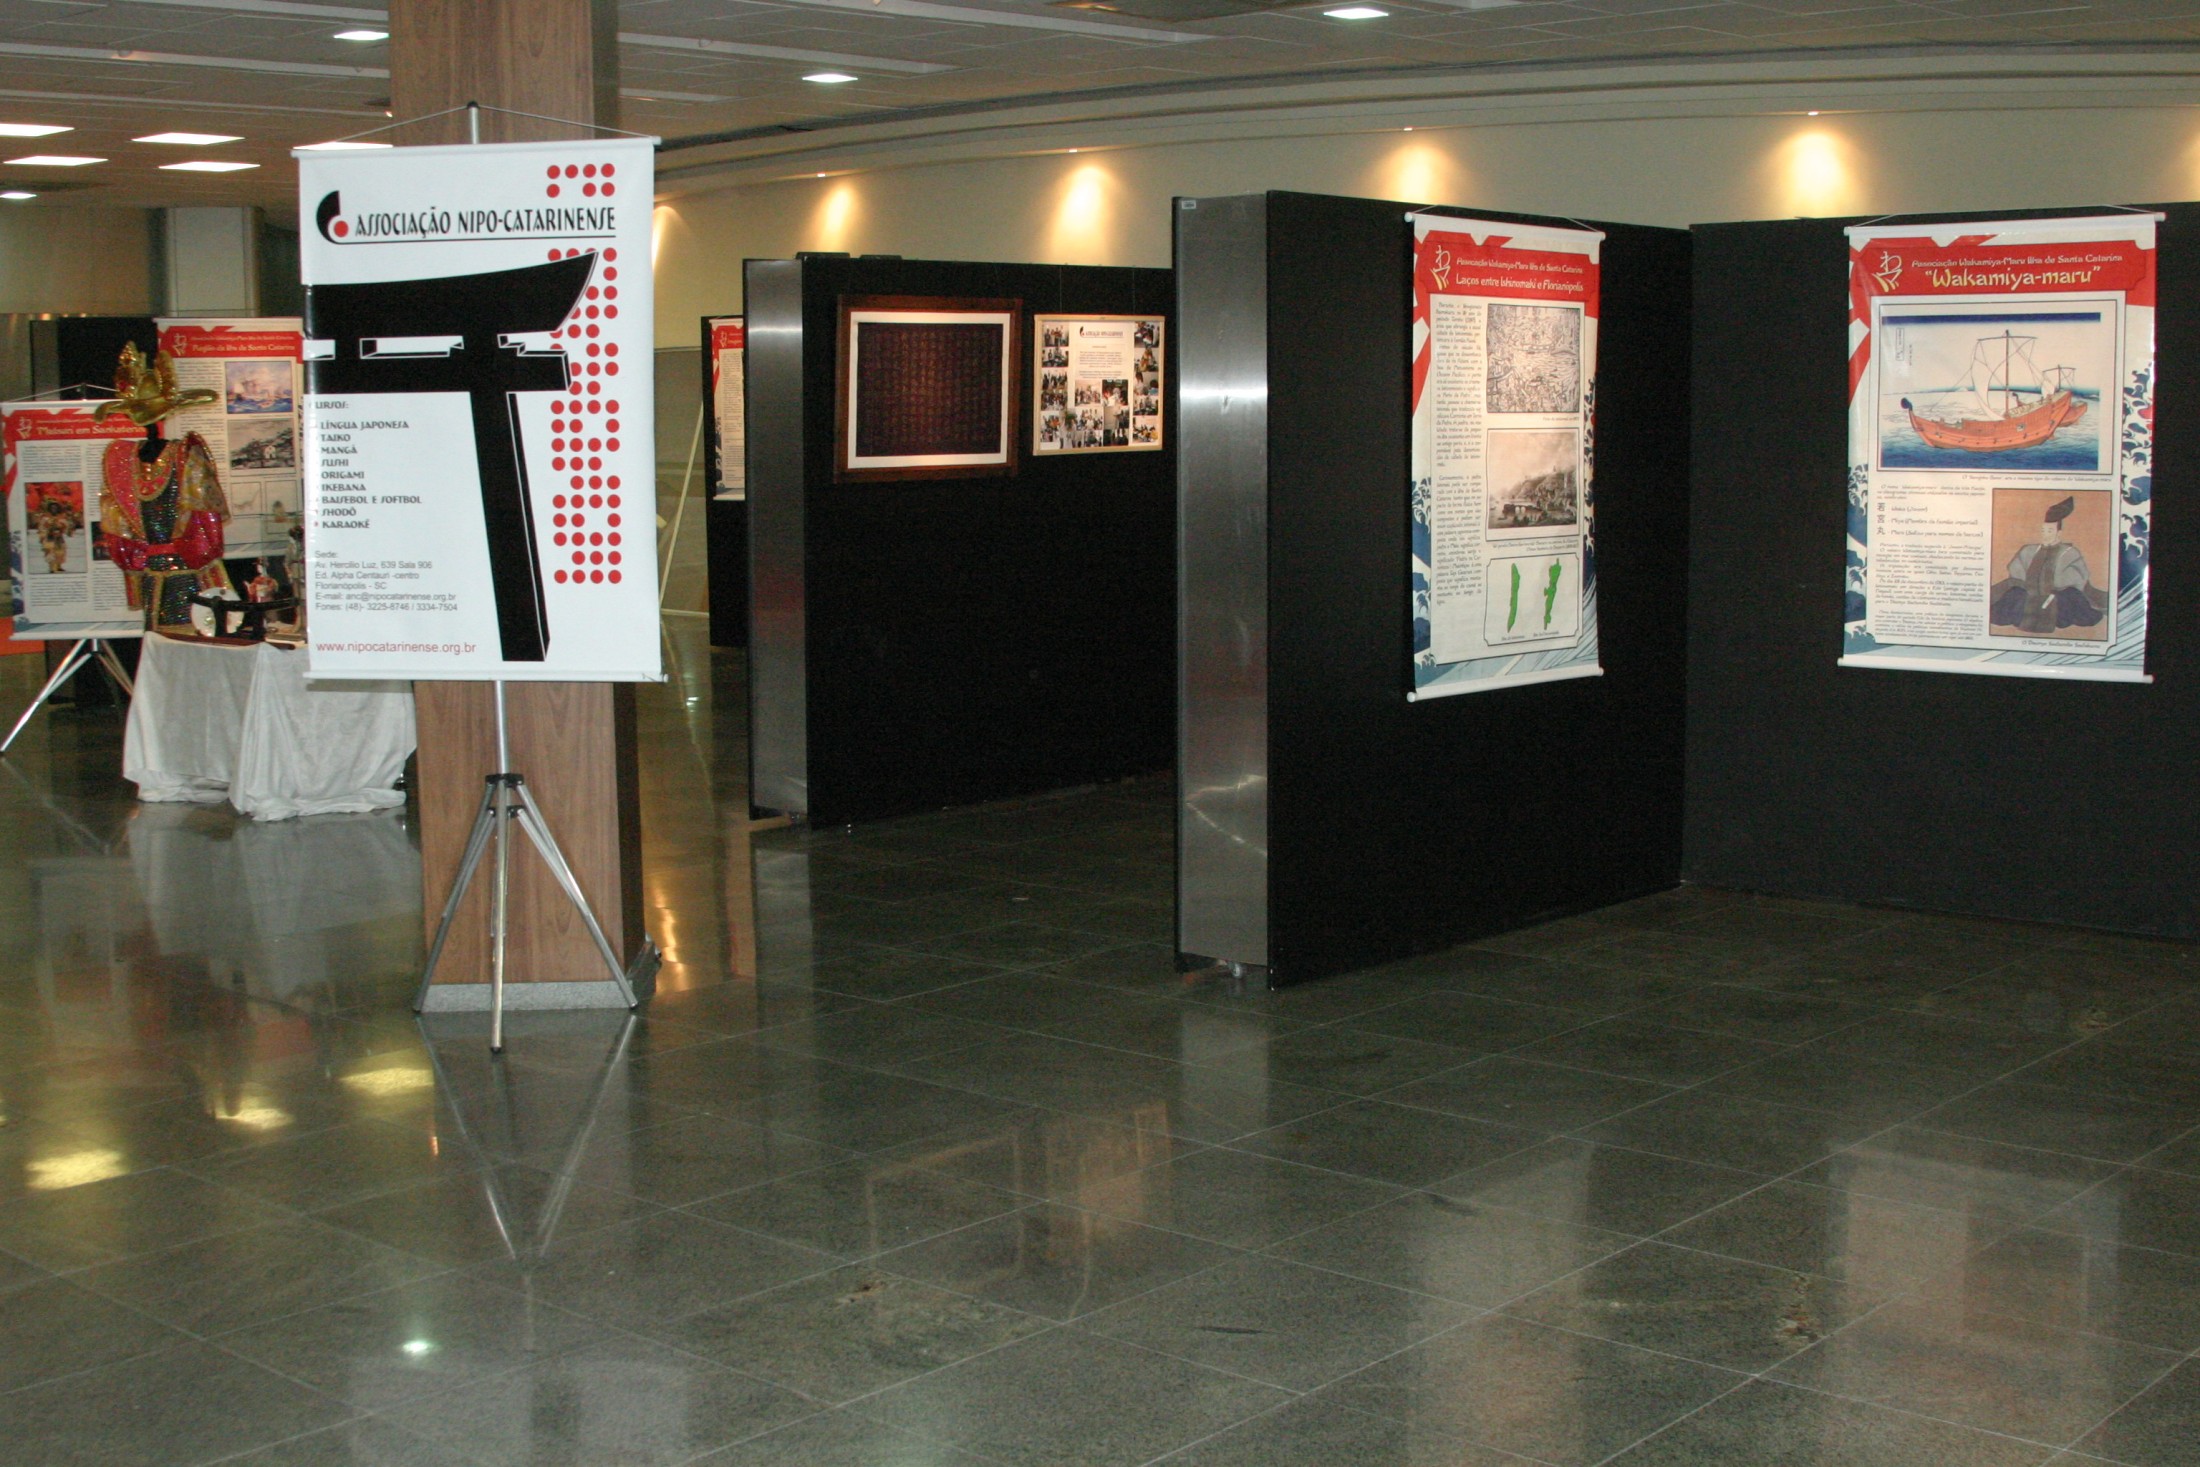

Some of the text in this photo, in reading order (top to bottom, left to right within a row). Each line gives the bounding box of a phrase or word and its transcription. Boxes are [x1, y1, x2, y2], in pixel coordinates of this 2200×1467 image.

[355, 206, 616, 238] ASSOCIAÇÃO NIPO-CATARINENSE
[1959, 257, 2025, 268] Wakamiya-Maru
[2058, 254, 2083, 263] Santa
[2085, 254, 2123, 262] Catarina
[1546, 264, 1561, 272] Santa
[1456, 274, 1480, 286] Laços
[1481, 277, 1500, 286] entre
[1500, 276, 1536, 289] Ishinomaki
[309, 401, 349, 409] URSOS:
[360, 420, 410, 430] JAPONESA
[321, 433, 351, 442] TAIKO
[321, 459, 349, 467] SUSHI
[321, 471, 365, 479] ORIGAMI
[322, 483, 367, 492] IKEBANA
[372, 496, 377, 504] E
[380, 495, 422, 504] SOFTBOL
[330, 571, 354, 581] Alpha
[374, 581, 388, 589] SC
[316, 641, 477, 656] www.nipocatarinense.org.br
